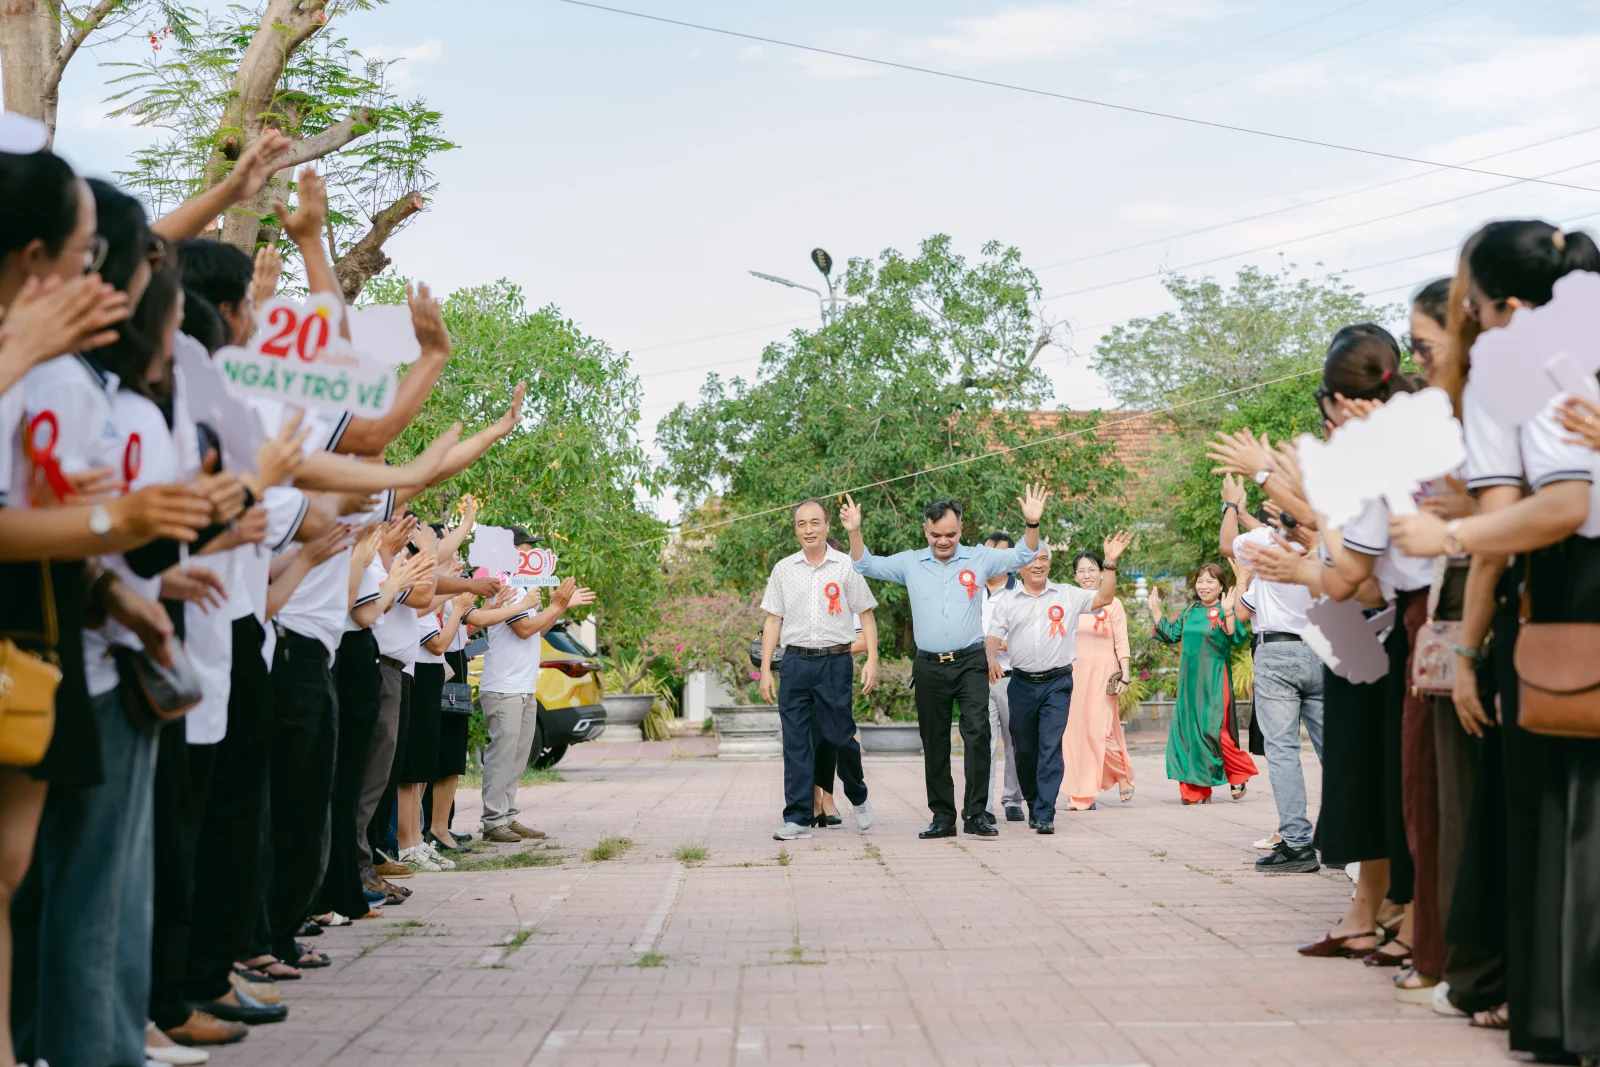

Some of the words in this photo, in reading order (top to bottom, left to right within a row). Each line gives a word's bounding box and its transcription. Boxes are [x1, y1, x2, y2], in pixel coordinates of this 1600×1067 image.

[260, 307, 329, 363] 20
[225, 361, 296, 393] NGÀY
[514, 551, 543, 576] 20
